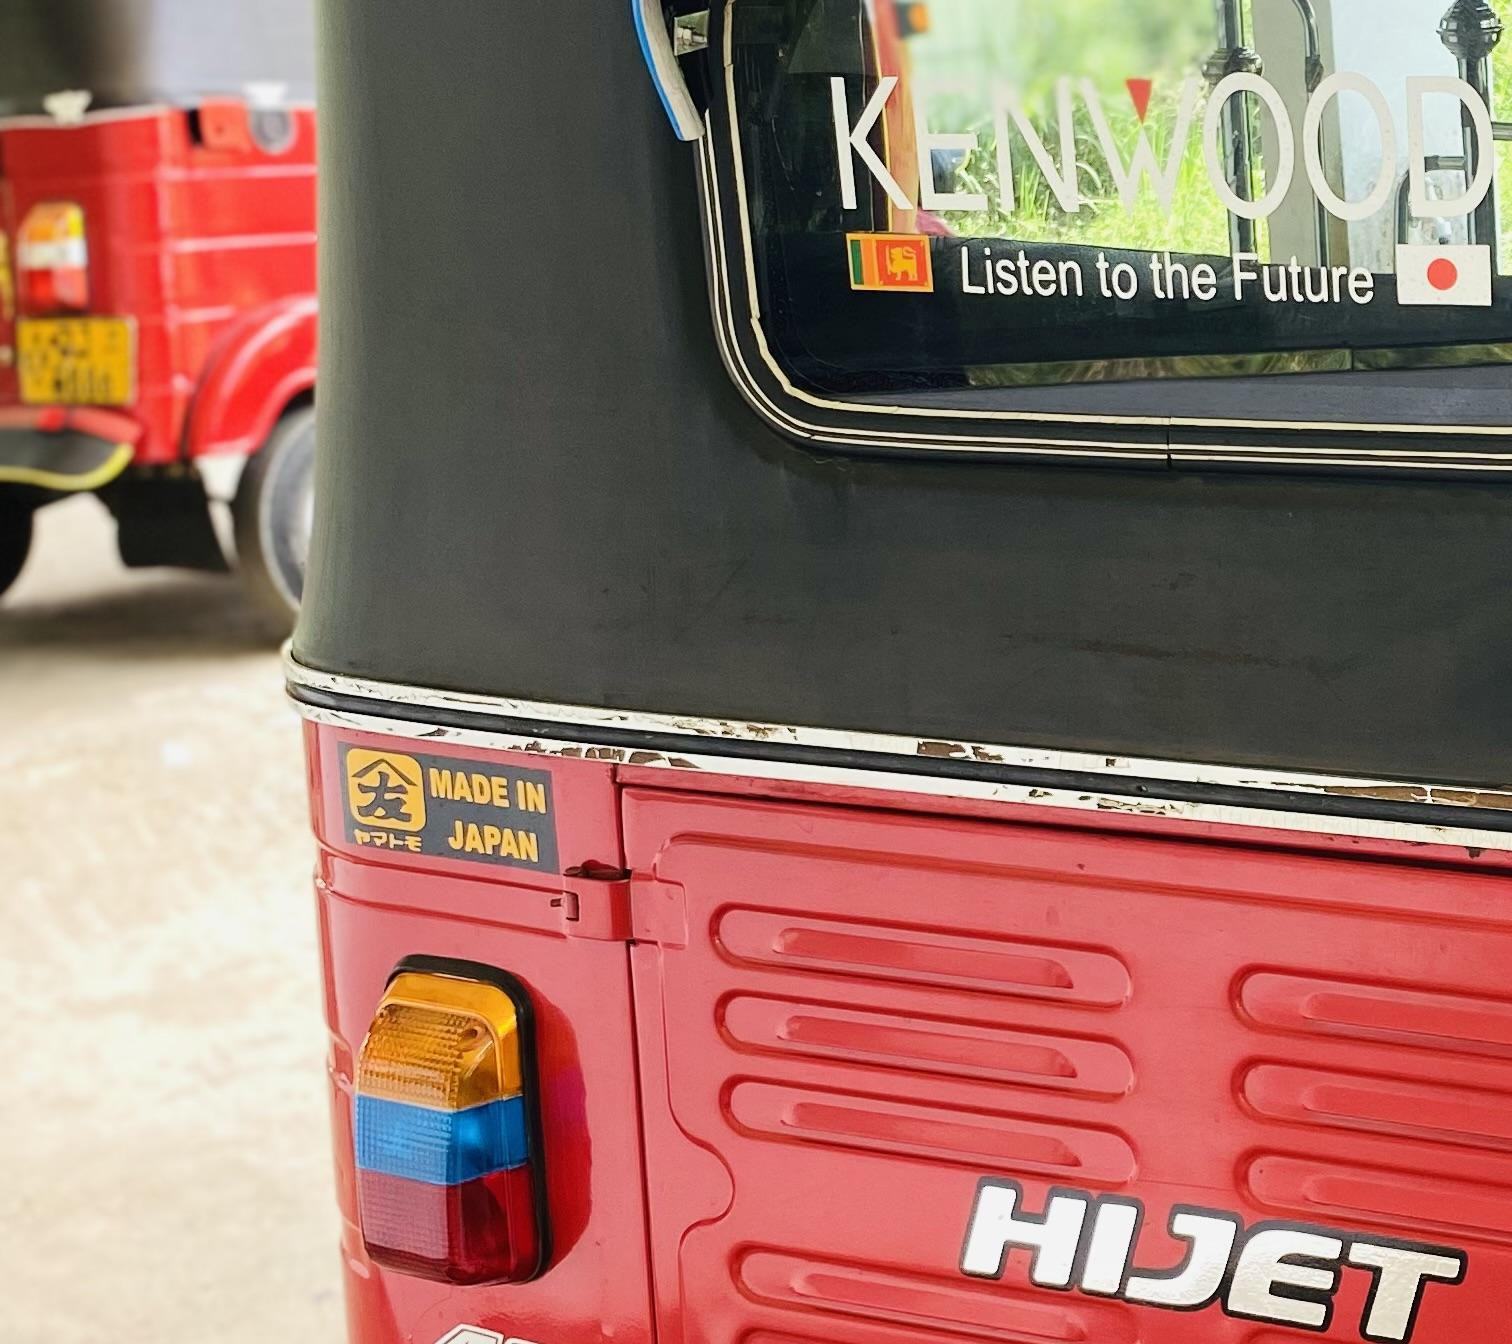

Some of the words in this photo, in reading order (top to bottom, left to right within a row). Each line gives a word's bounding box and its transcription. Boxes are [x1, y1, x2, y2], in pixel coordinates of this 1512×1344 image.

[830, 71, 1494, 221] KENWOOD
[961, 246, 1083, 297] Listen
[1096, 252, 1138, 299] to
[1149, 252, 1217, 301] the
[1232, 252, 1375, 305] Future
[429, 767, 510, 809] MADE
[516, 779, 547, 814] IN
[353, 829, 422, 853] ヤマトモ
[448, 820, 539, 862] JAPAN
